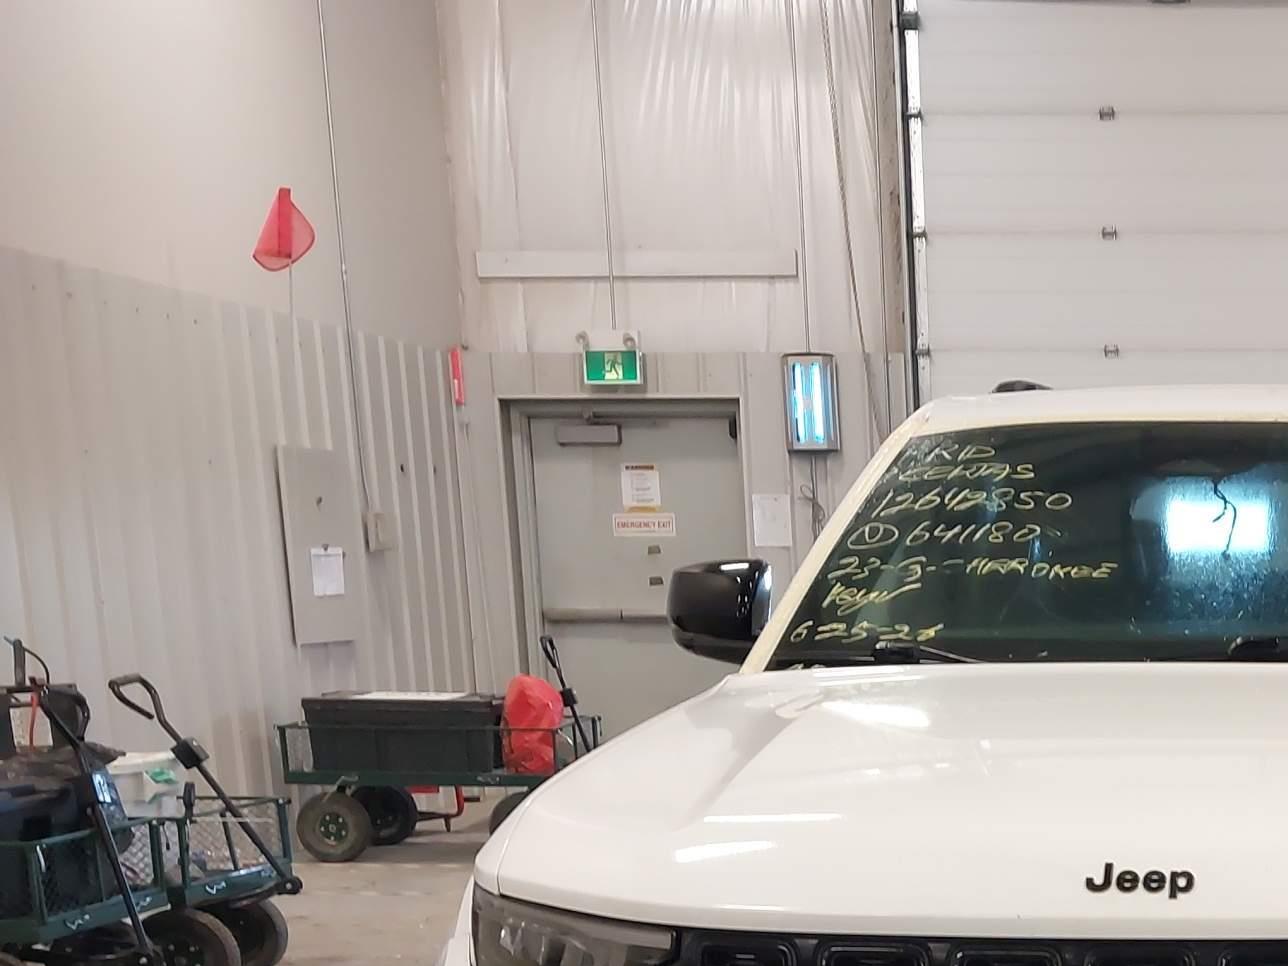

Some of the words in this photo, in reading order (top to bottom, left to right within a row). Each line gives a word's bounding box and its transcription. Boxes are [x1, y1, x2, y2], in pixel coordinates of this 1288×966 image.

[617, 520, 656, 529] EMERGENCY
[657, 519, 671, 529] EXIT
[1086, 862, 1195, 900] Jeep
